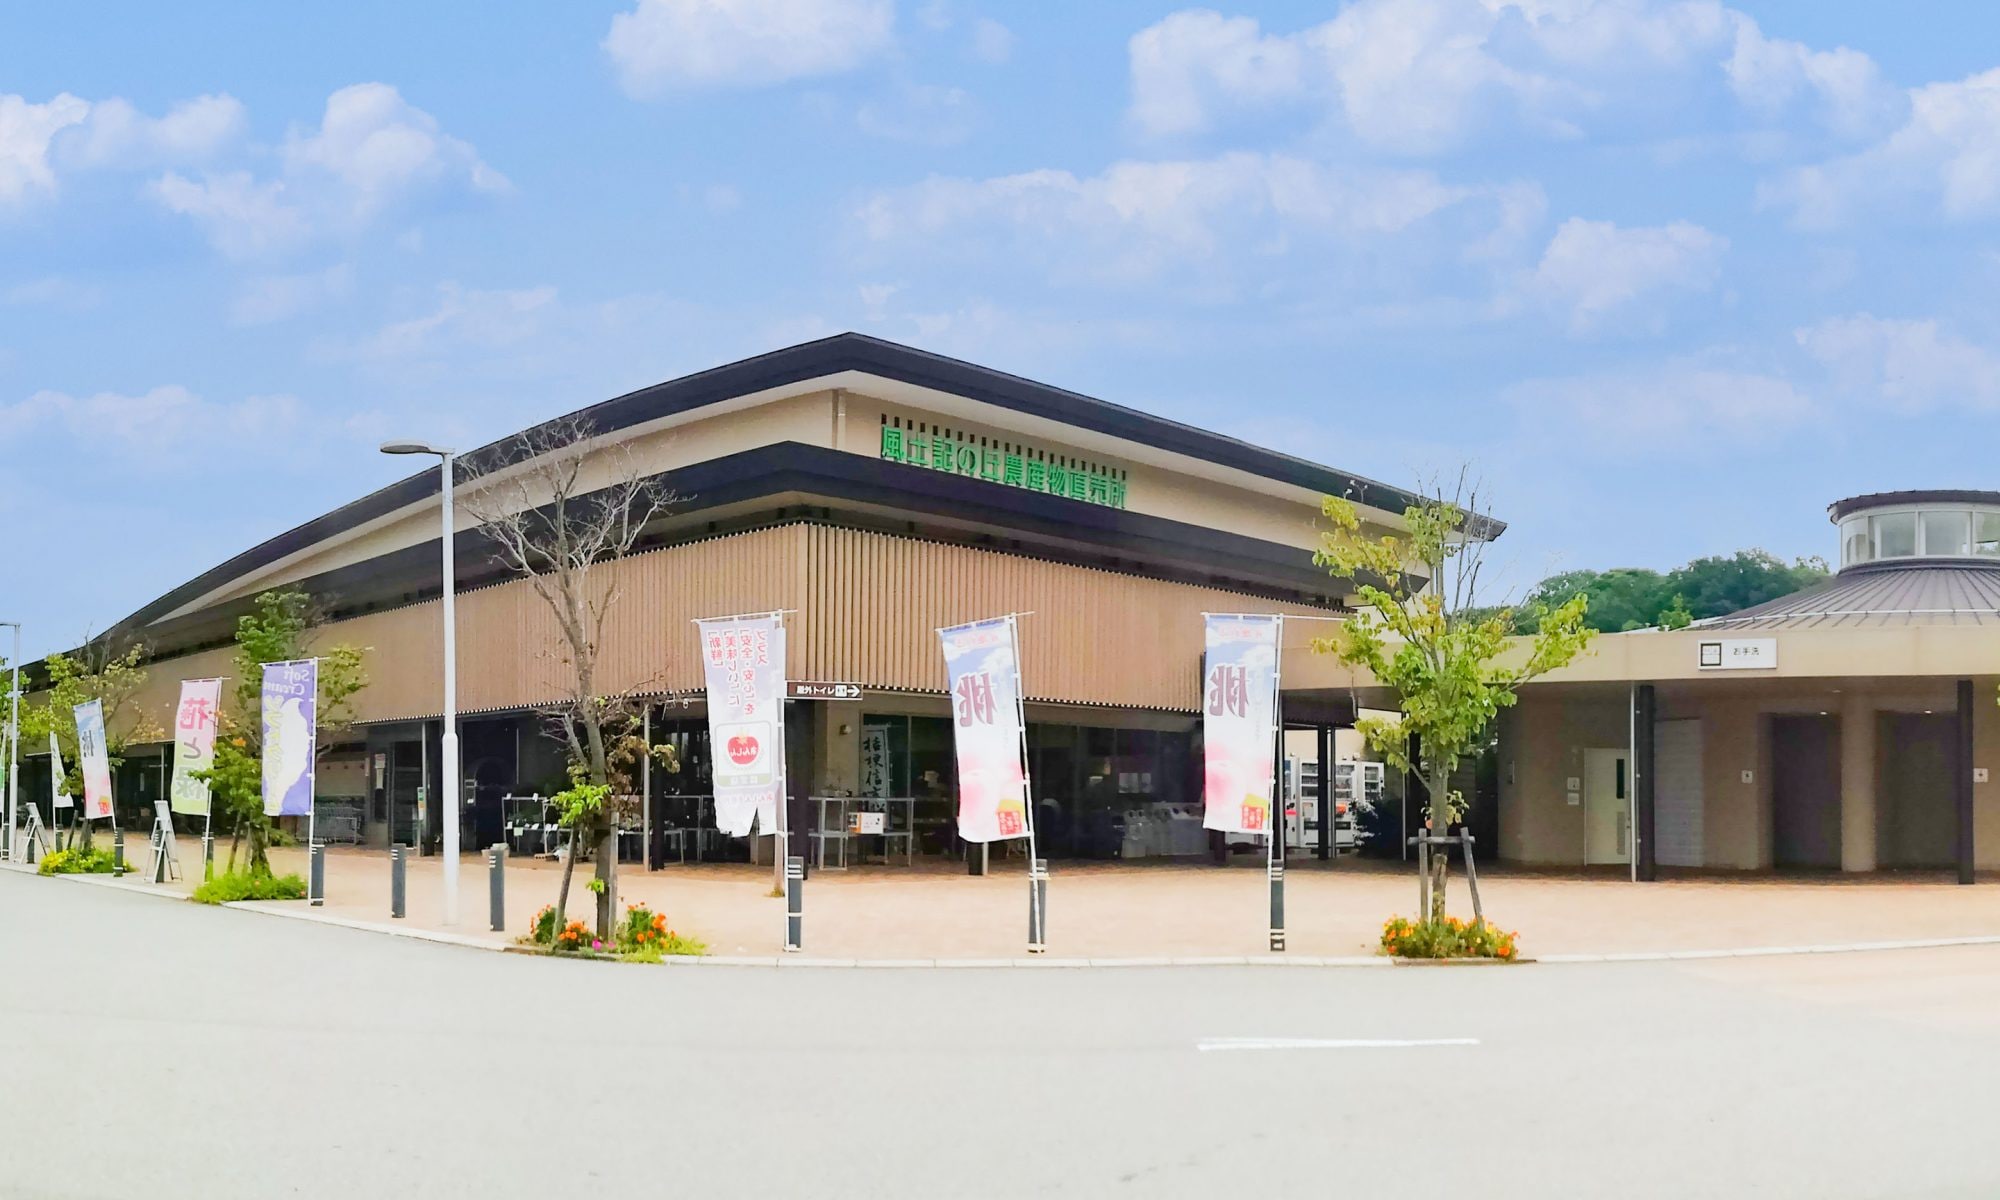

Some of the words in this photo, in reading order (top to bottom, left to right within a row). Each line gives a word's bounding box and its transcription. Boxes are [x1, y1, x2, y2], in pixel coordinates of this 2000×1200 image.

[881, 424, 1128, 509] 風土記の丘農産物直売所
[1732, 647, 1760, 656] お手洗
[796, 685, 835, 696] 屋外トイレ
